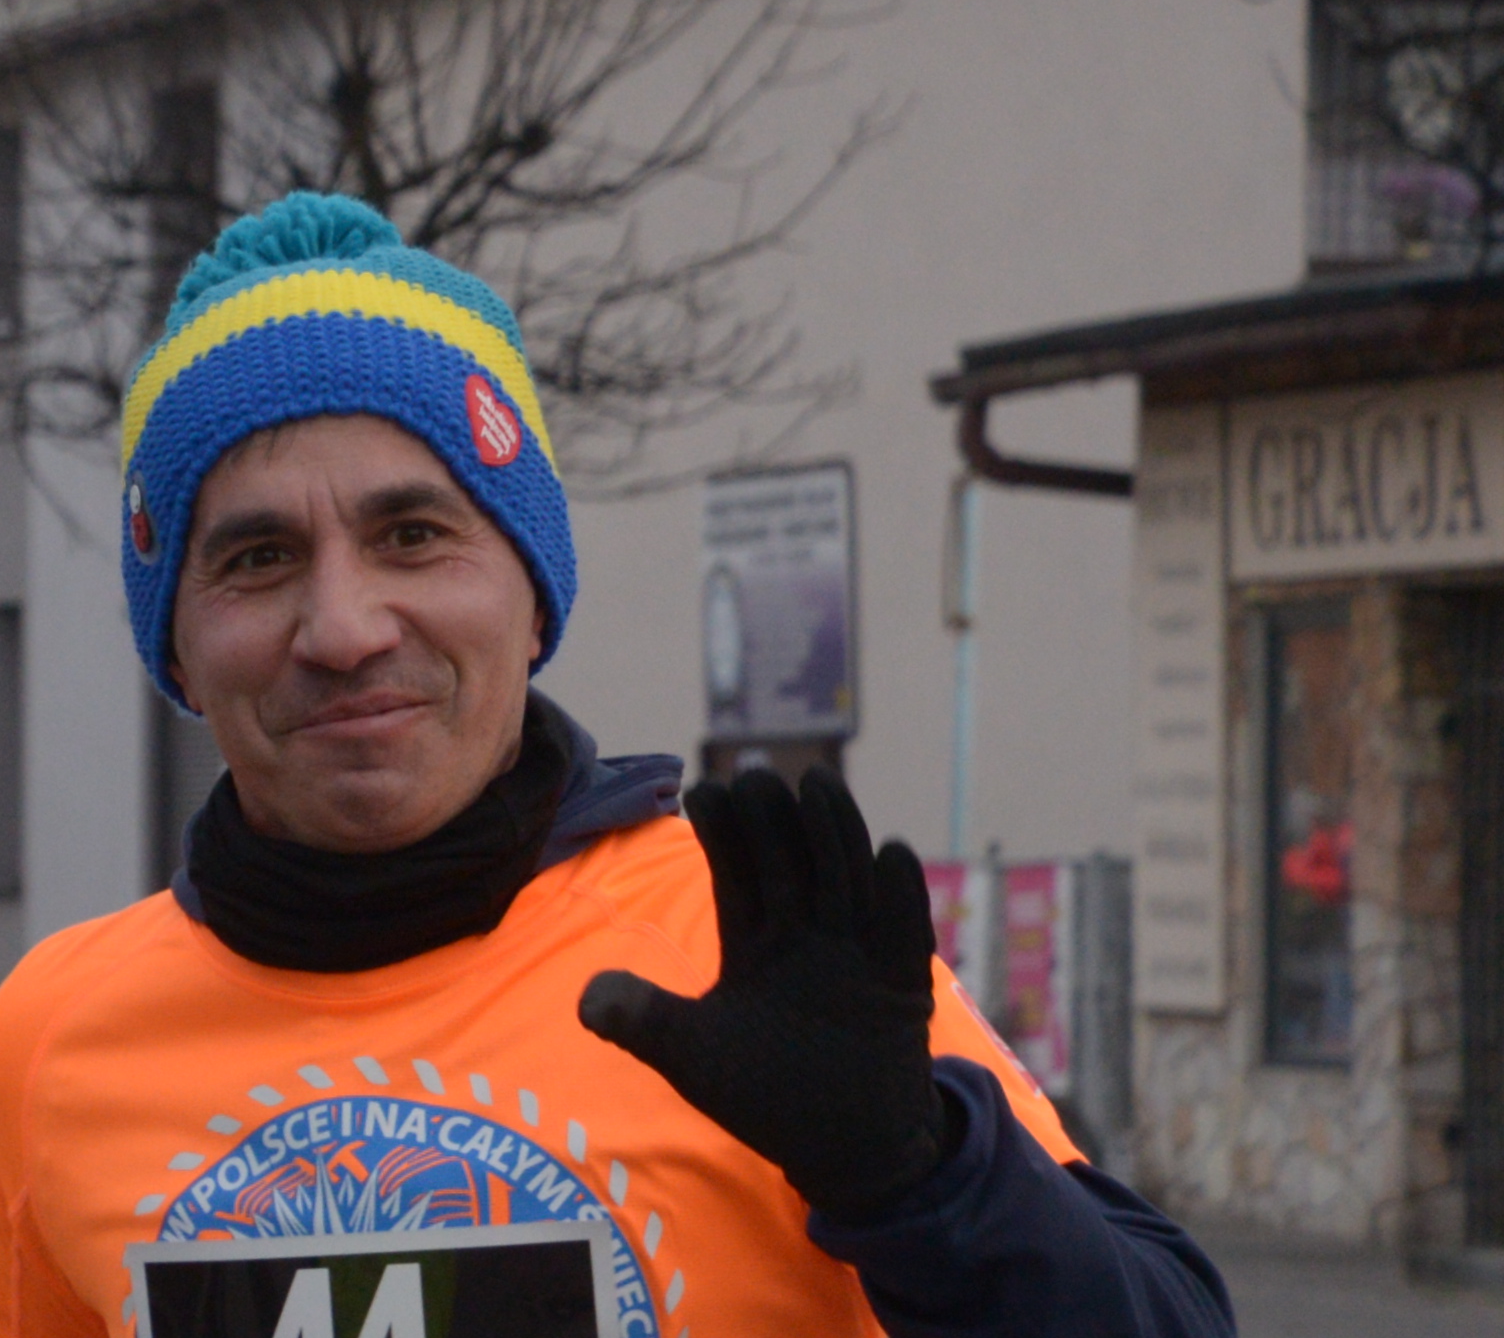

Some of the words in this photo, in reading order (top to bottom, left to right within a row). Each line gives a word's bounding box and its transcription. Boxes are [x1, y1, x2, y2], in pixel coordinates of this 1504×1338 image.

[1248, 411, 1485, 551] GRACJA
[191, 1104, 331, 1214] POLSCE
[342, 1101, 352, 1137] I
[364, 1101, 428, 1143] NA
[438, 1116, 576, 1213] CAŁYM
